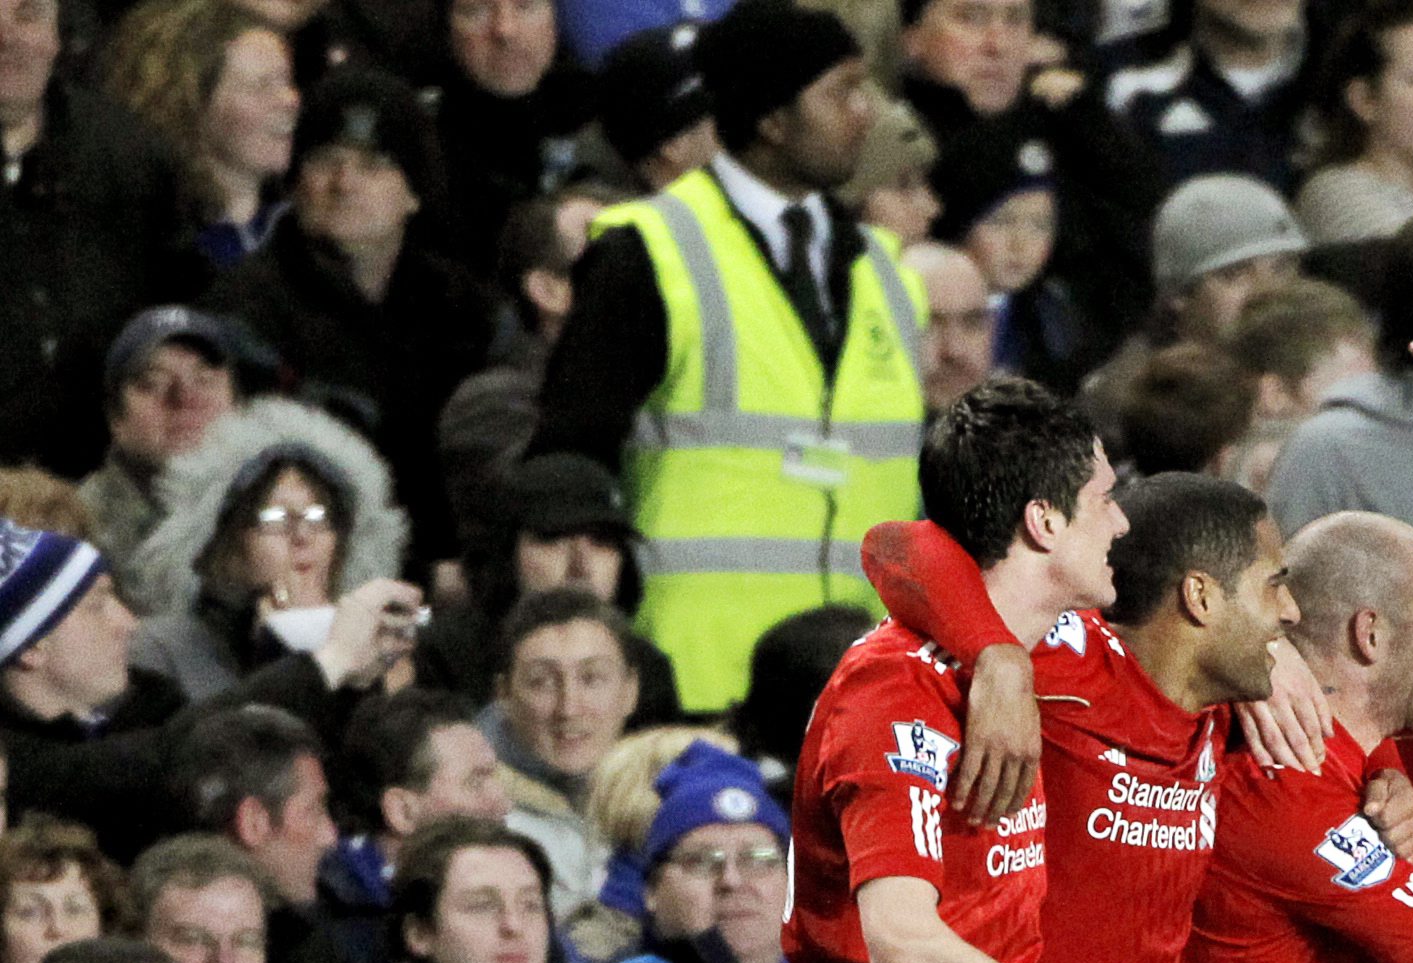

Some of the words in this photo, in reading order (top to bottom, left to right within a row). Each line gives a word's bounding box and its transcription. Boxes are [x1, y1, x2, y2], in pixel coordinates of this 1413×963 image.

[1108, 772, 1204, 812] Standard
[997, 797, 1046, 837] Standa
[1087, 807, 1196, 850] Chartered
